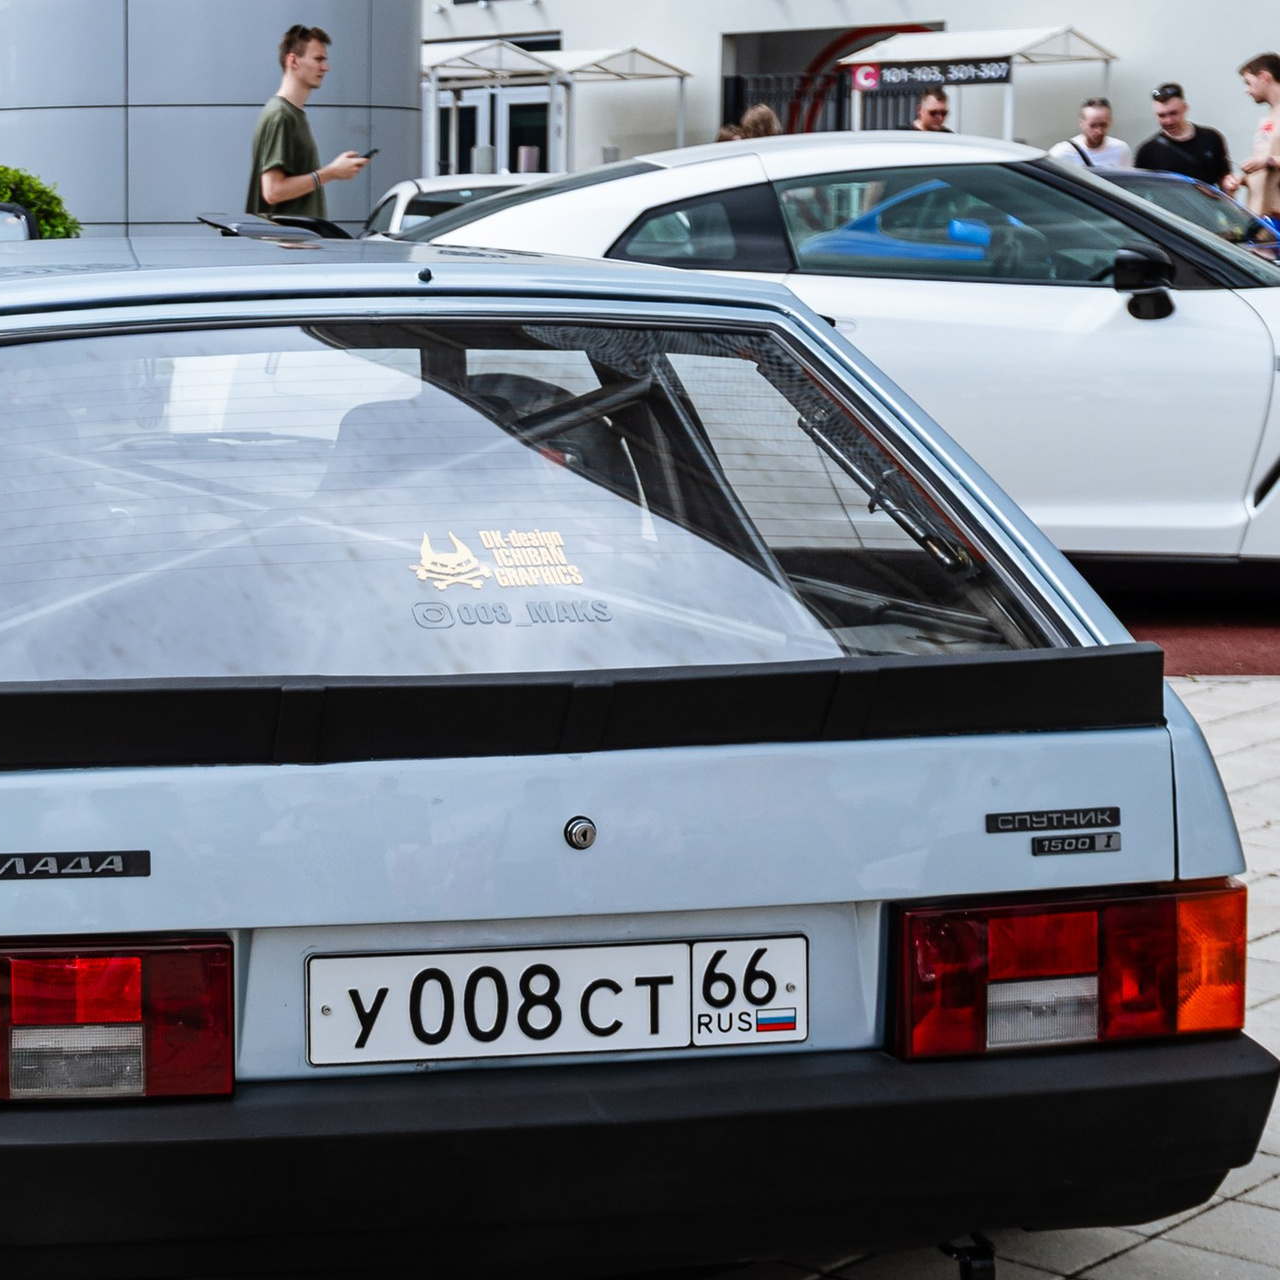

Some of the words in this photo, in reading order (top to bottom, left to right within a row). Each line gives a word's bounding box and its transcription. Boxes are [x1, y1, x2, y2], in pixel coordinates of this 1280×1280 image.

[478, 529, 565, 549] DK-design
[492, 546, 568, 567] ICHIBAN
[493, 565, 584, 588] GRAPHICS
[997, 810, 1112, 830] СПУТНИК
[1042, 838, 1090, 852] 1500
[702, 947, 777, 1009] 66
[696, 1011, 754, 1035] RUS
